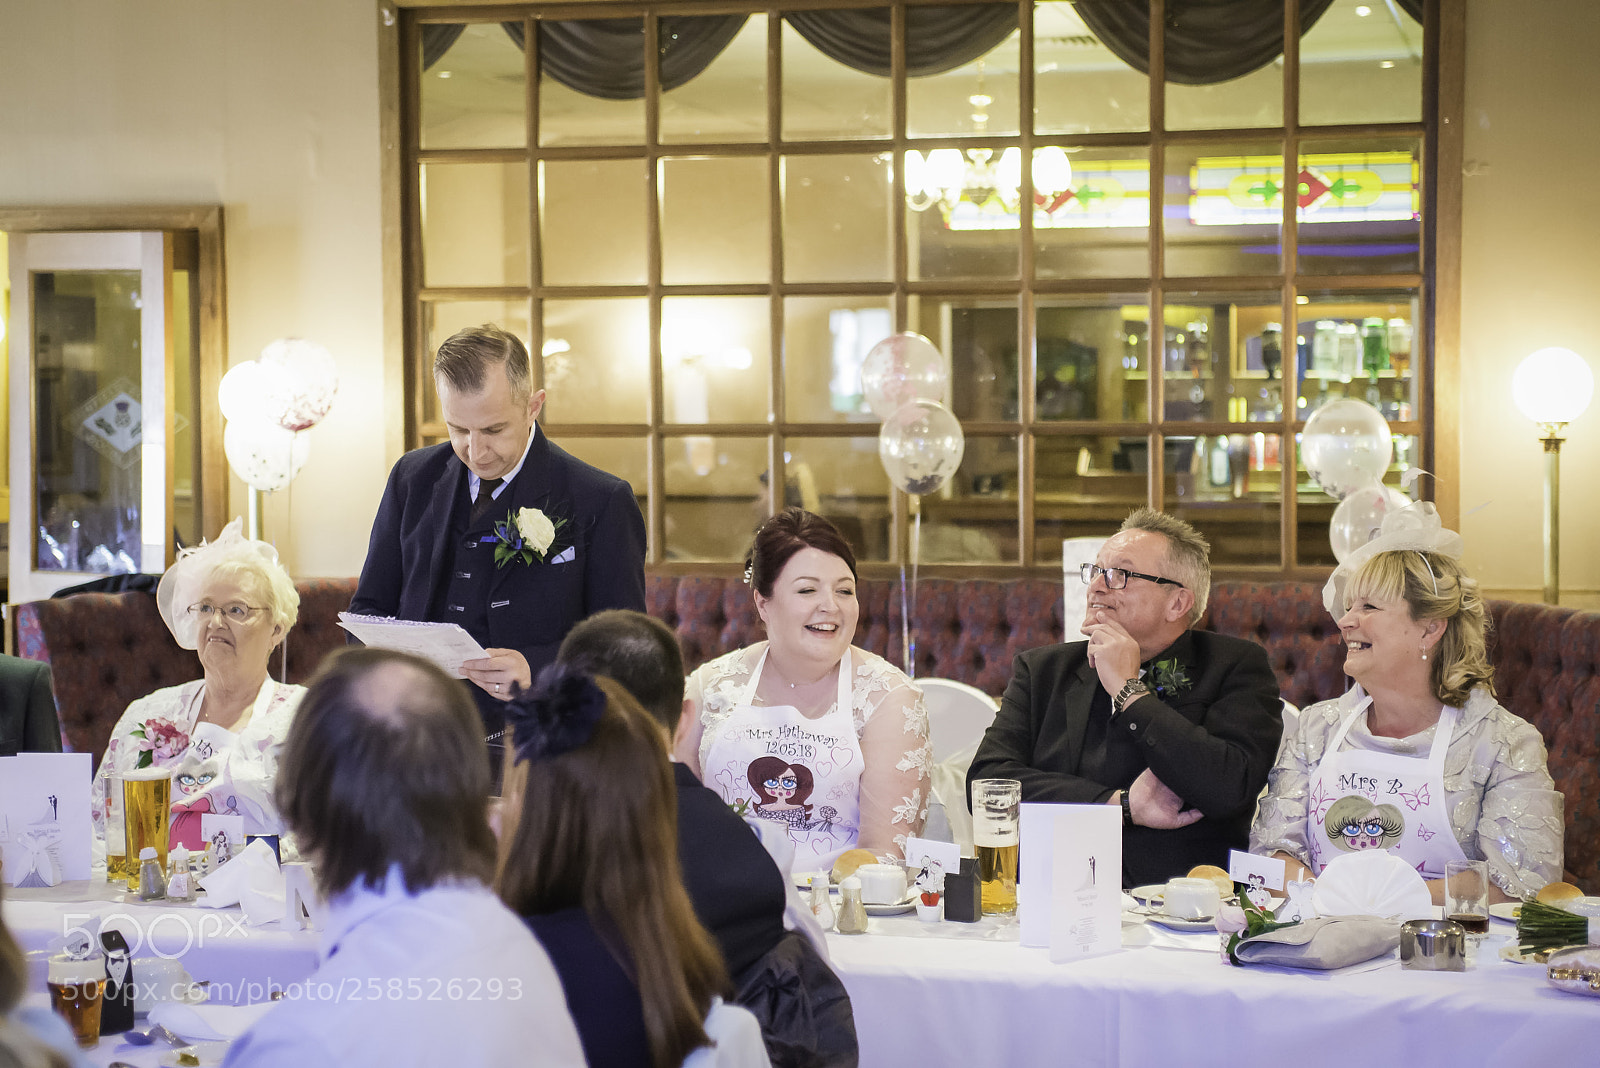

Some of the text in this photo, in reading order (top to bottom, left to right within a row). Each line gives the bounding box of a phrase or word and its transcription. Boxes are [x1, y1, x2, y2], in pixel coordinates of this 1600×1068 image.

[746, 723, 839, 749] Mrs Hathaway
[765, 740, 812, 758] 12.05.18
[1338, 772, 1403, 795] Mrs B
